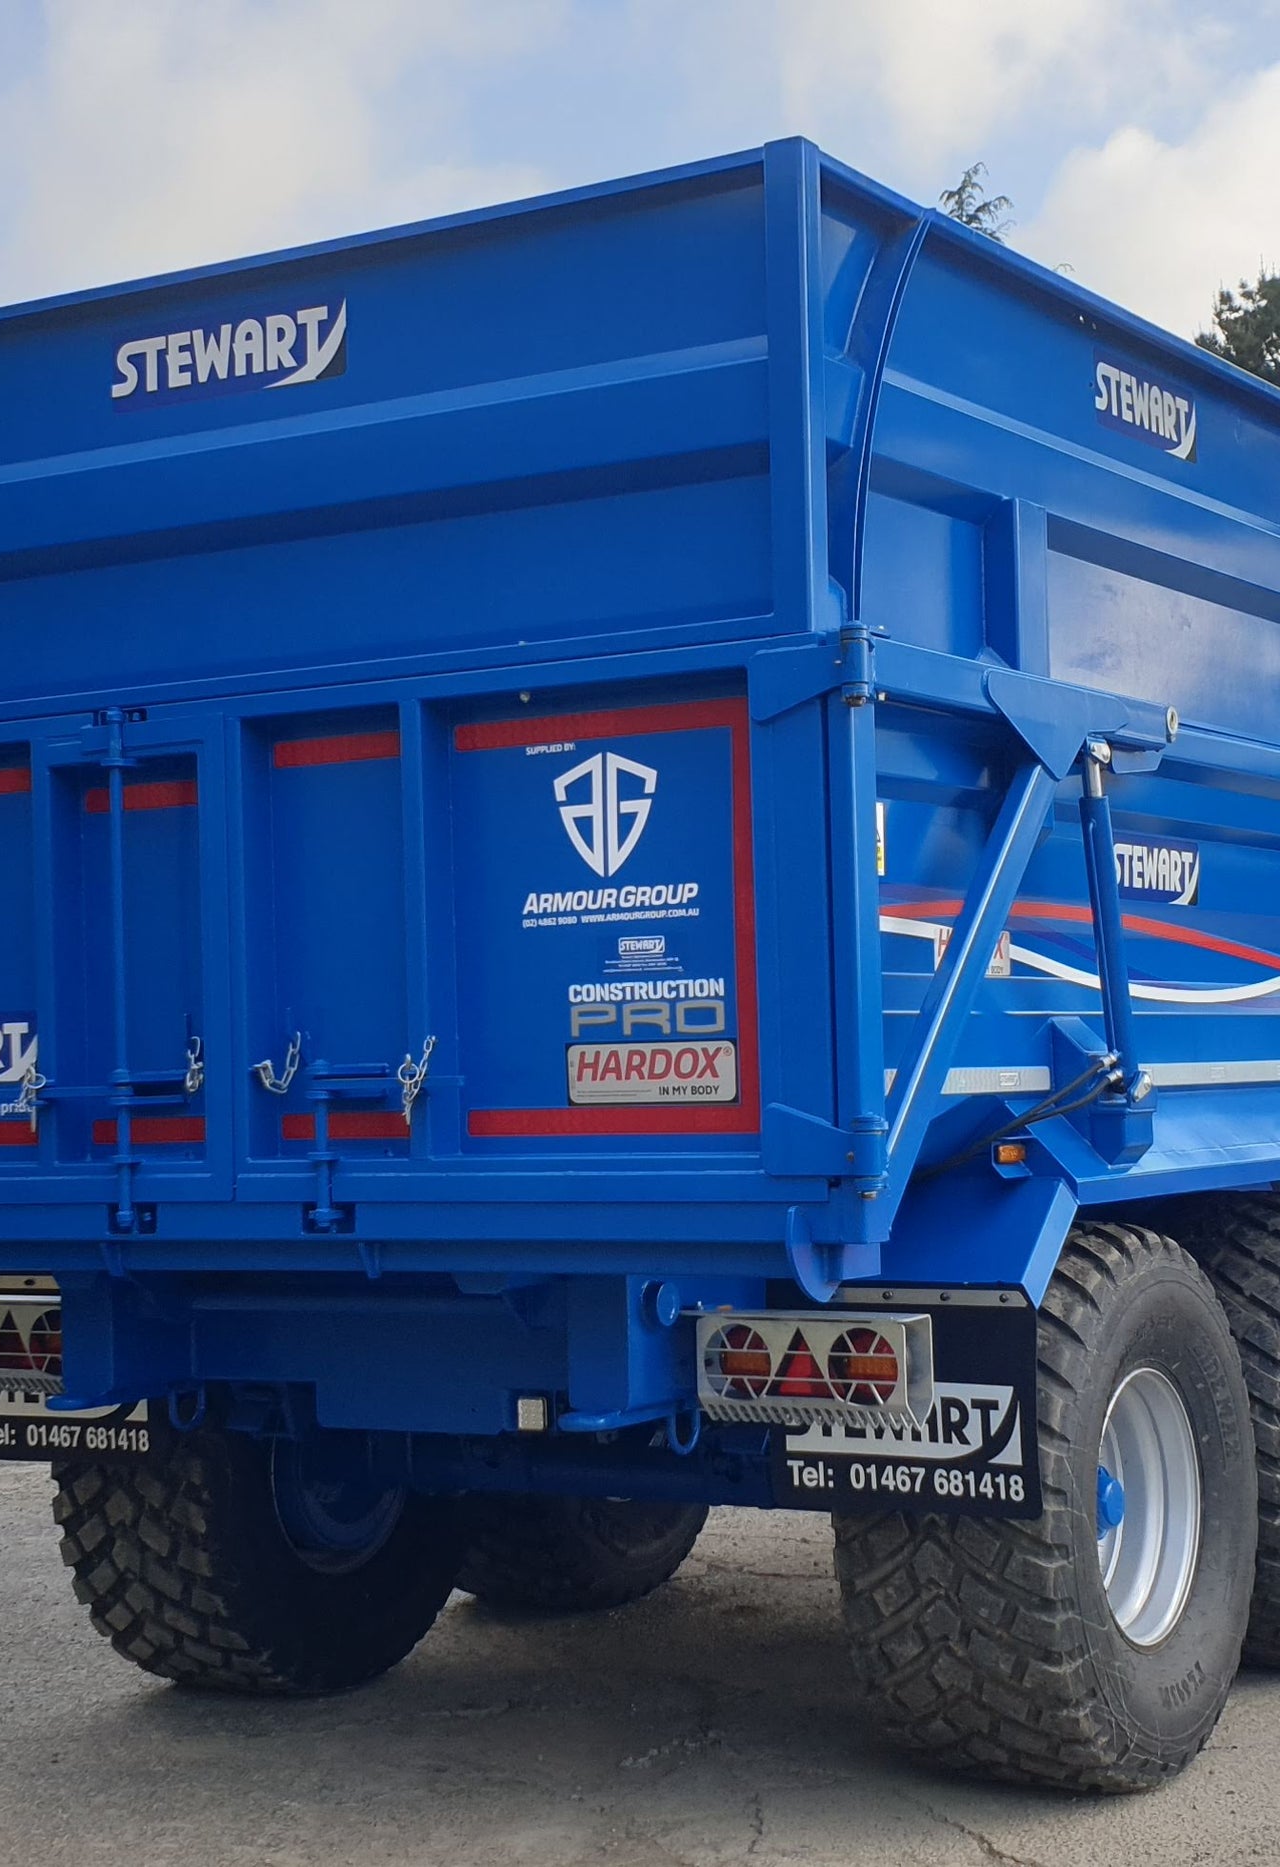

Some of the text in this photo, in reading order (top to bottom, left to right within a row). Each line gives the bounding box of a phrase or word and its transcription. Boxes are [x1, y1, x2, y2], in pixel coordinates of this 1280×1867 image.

[111, 297, 347, 398] STEWART
[1095, 361, 1197, 460] STEWART
[525, 743, 563, 756] SUPPLIED
[522, 882, 700, 915] ARMOUR GROUP
[619, 938, 665, 953] STEWART
[568, 978, 725, 1003] CONSTRUCTION
[570, 999, 726, 1038] PRO
[658, 1086, 671, 1096] IN
[672, 1085, 689, 1096] MY
[691, 1084, 721, 1096] BODY
[26, 1424, 82, 1448] 01467
[85, 1426, 150, 1453] 681418
[786, 1459, 1026, 1502] Tel: 01467 681418
